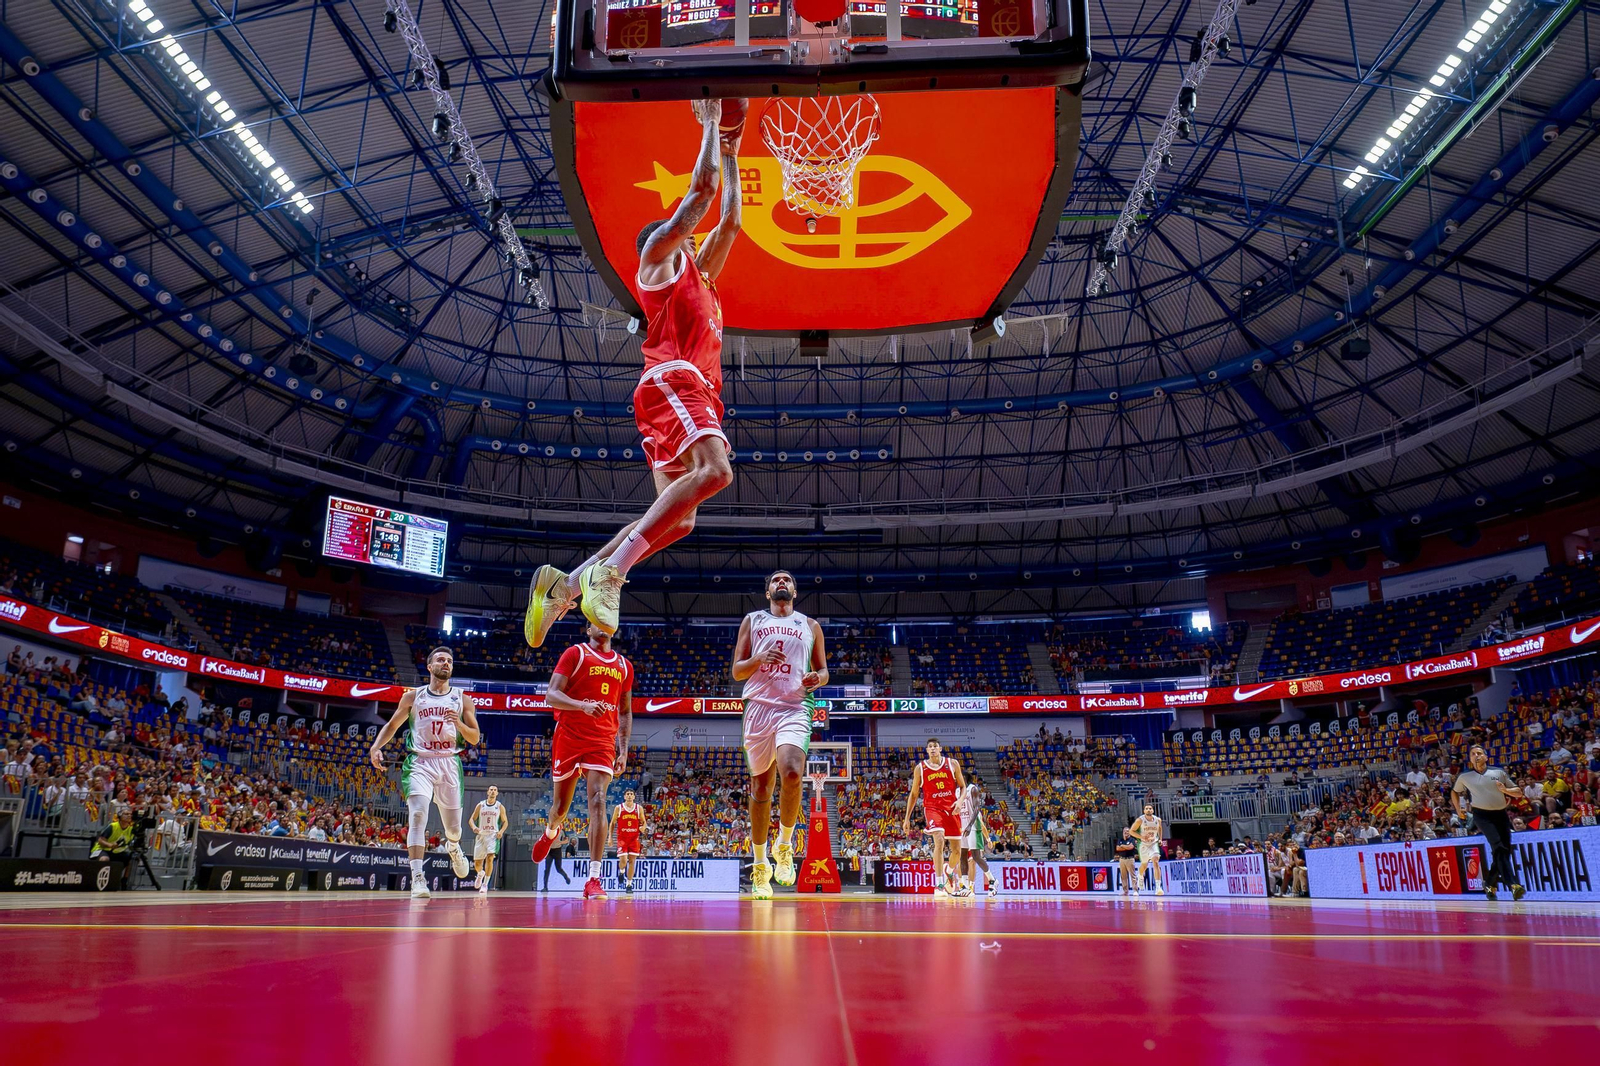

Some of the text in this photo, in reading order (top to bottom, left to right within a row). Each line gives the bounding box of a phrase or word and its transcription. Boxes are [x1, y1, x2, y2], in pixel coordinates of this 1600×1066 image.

[672, 14, 681, 22] 17
[739, 168, 763, 206] FEB
[394, 513, 404, 522] 20
[380, 532, 400, 542] 1:49
[758, 626, 803, 641] PORTUGAL
[142, 648, 188, 667] endesa
[218, 662, 260, 680] CaixaBank
[1426, 657, 1472, 674] CaixaBank
[589, 666, 622, 683] ESPAÑA
[1340, 672, 1391, 688] endesa
[601, 683, 609, 695] 8
[712, 701, 743, 710] ESPAÑA
[871, 700, 887, 711] 23
[900, 700, 918, 710] 20
[938, 702, 982, 710] PORTUGAL
[1023, 699, 1067, 709] endesa
[1098, 698, 1140, 706] CaixaBank
[812, 709, 826, 721] 23
[432, 721, 443, 735] 17
[424, 740, 450, 750] una
[235, 844, 266, 858] endesa
[279, 848, 300, 859] CaixaBank
[350, 853, 369, 864] endesa
[432, 859, 448, 868] endesa
[573, 860, 613, 878] MAID
[670, 860, 704, 878] ARENA
[1375, 842, 1429, 892] ESPAÑA
[14, 871, 82, 886] #LaFamilia
[1002, 861, 1056, 890] ESPAÑA
[608, 879, 616, 890] DE
[618, 878, 642, 890] AGSTO
[650, 878, 668, 890] 20:00
